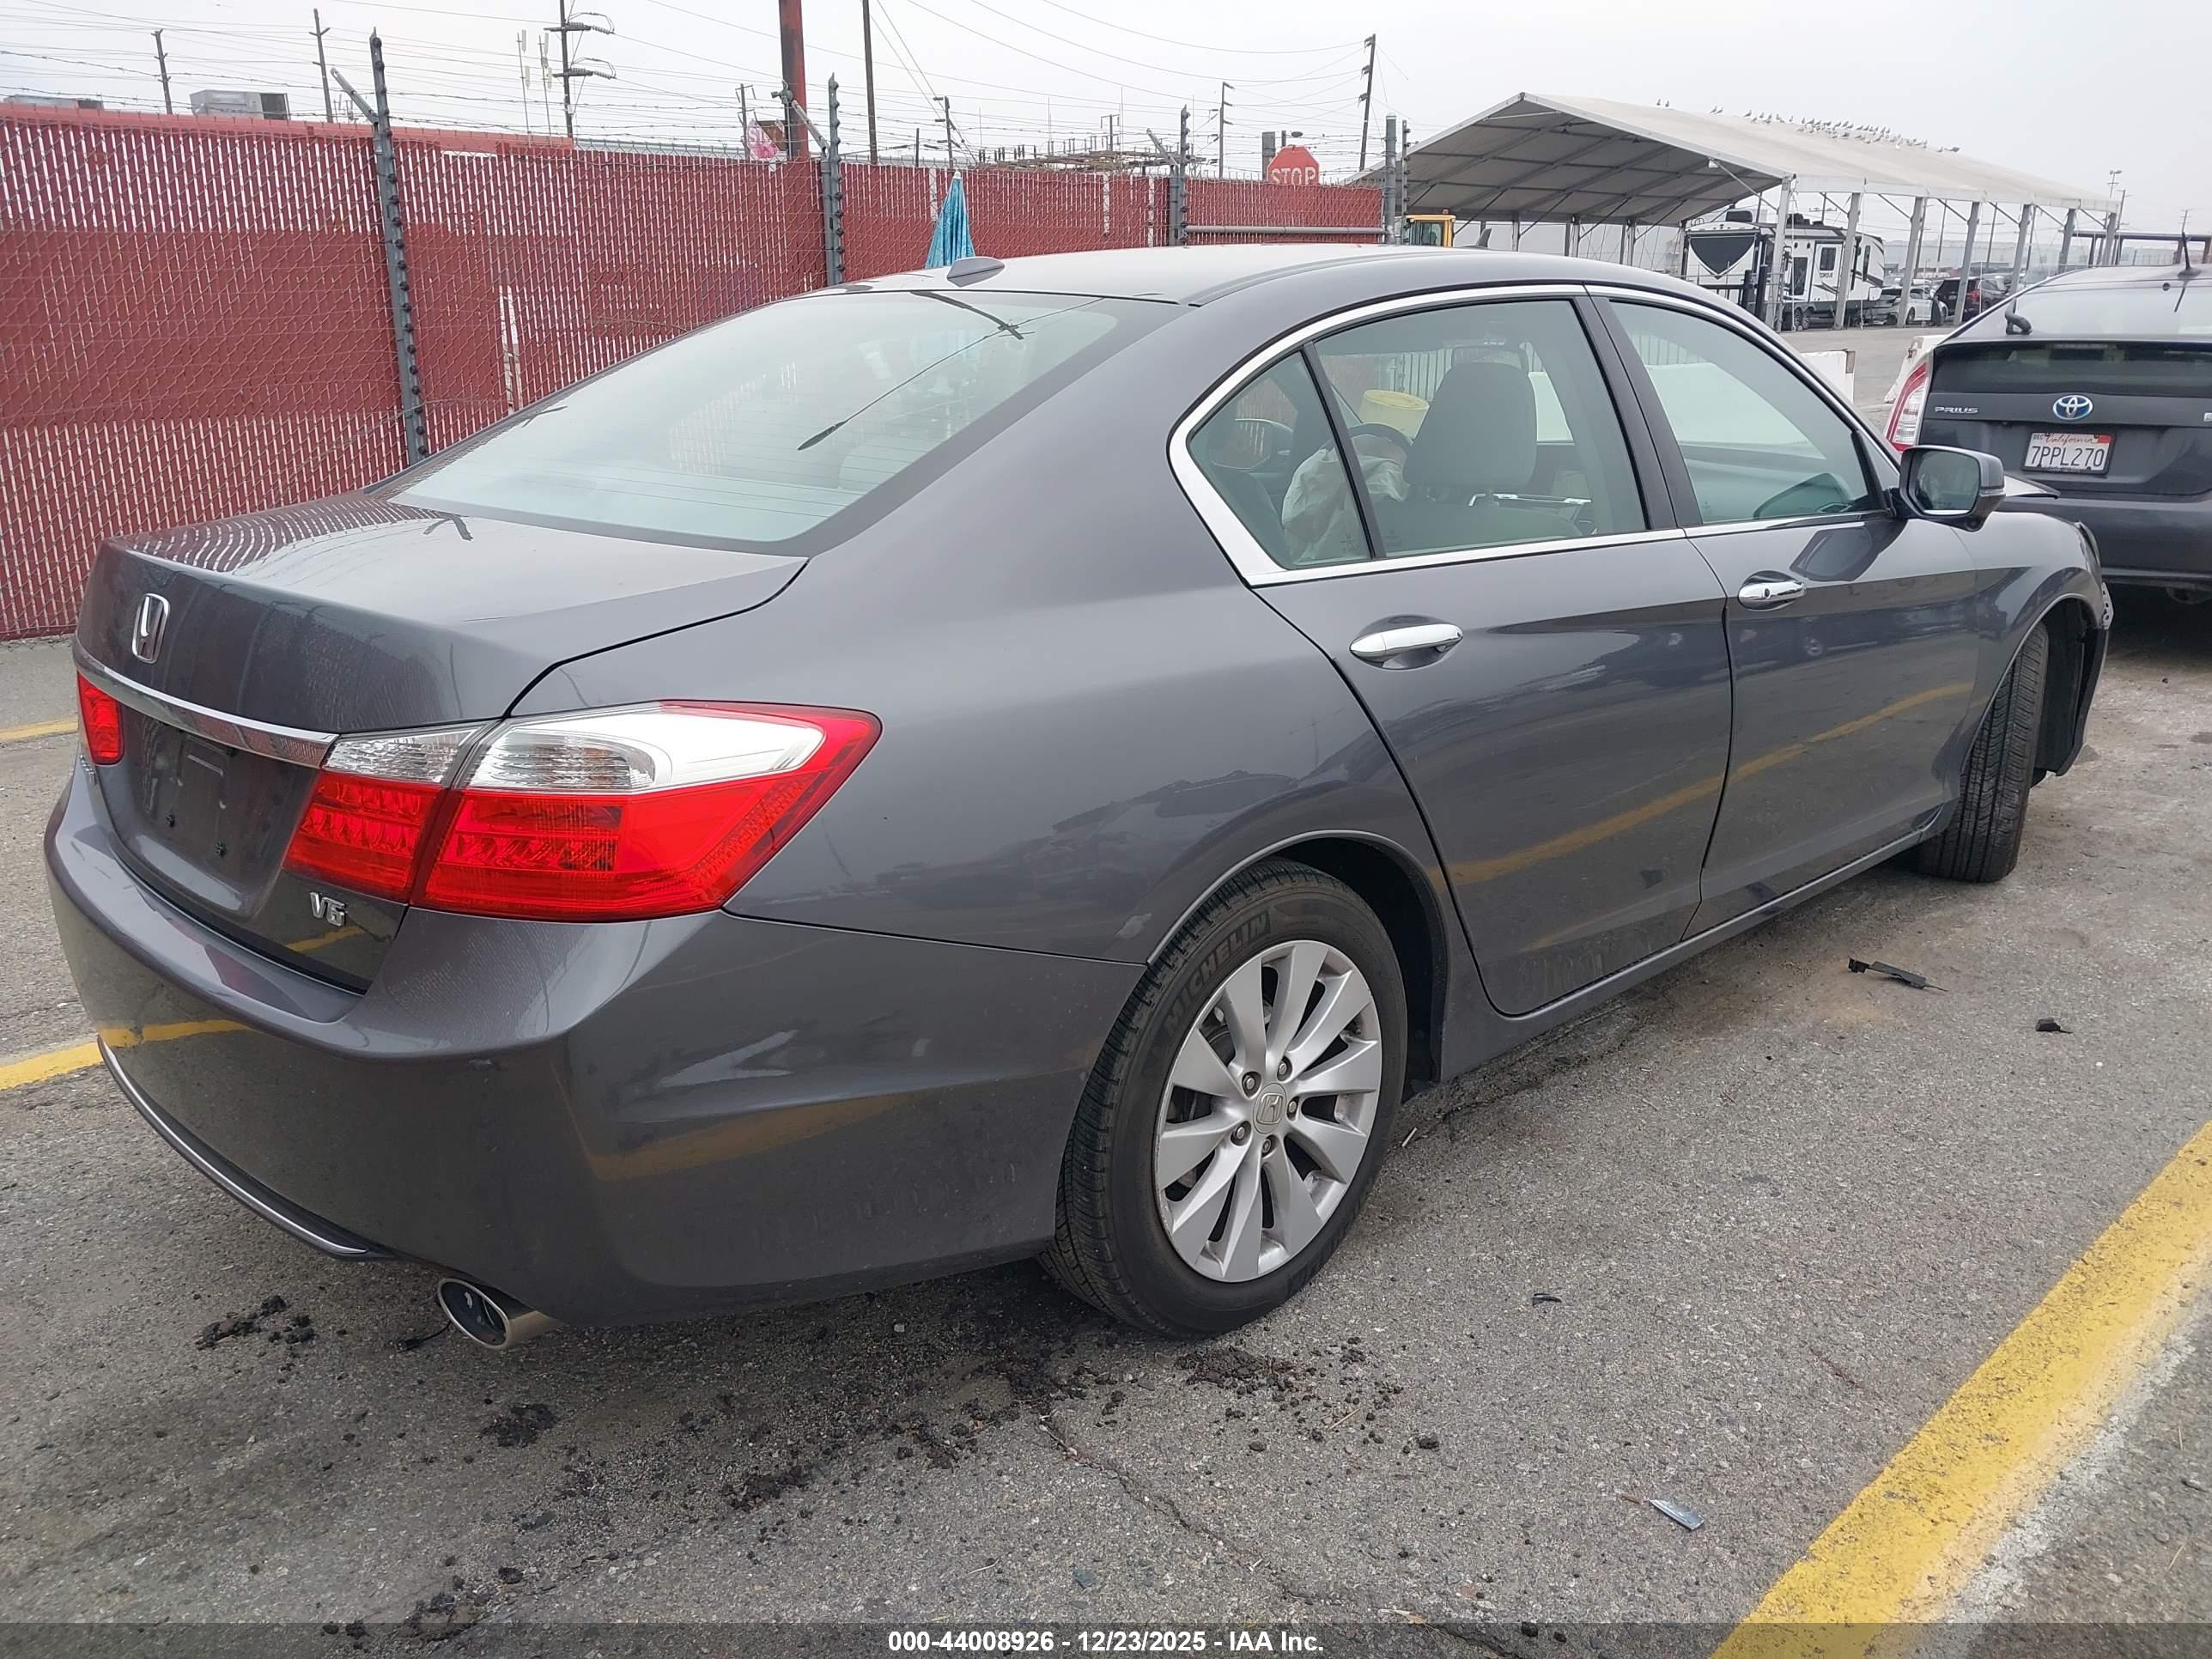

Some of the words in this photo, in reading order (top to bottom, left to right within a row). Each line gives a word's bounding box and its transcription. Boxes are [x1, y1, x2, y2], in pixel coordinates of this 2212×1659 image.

[1271, 167, 1316, 185] STOP
[2045, 433, 2097, 446] California
[2031, 445, 2105, 467] 7PPL270
[309, 891, 345, 927] V6
[1163, 908, 1272, 1029] MICHELIN
